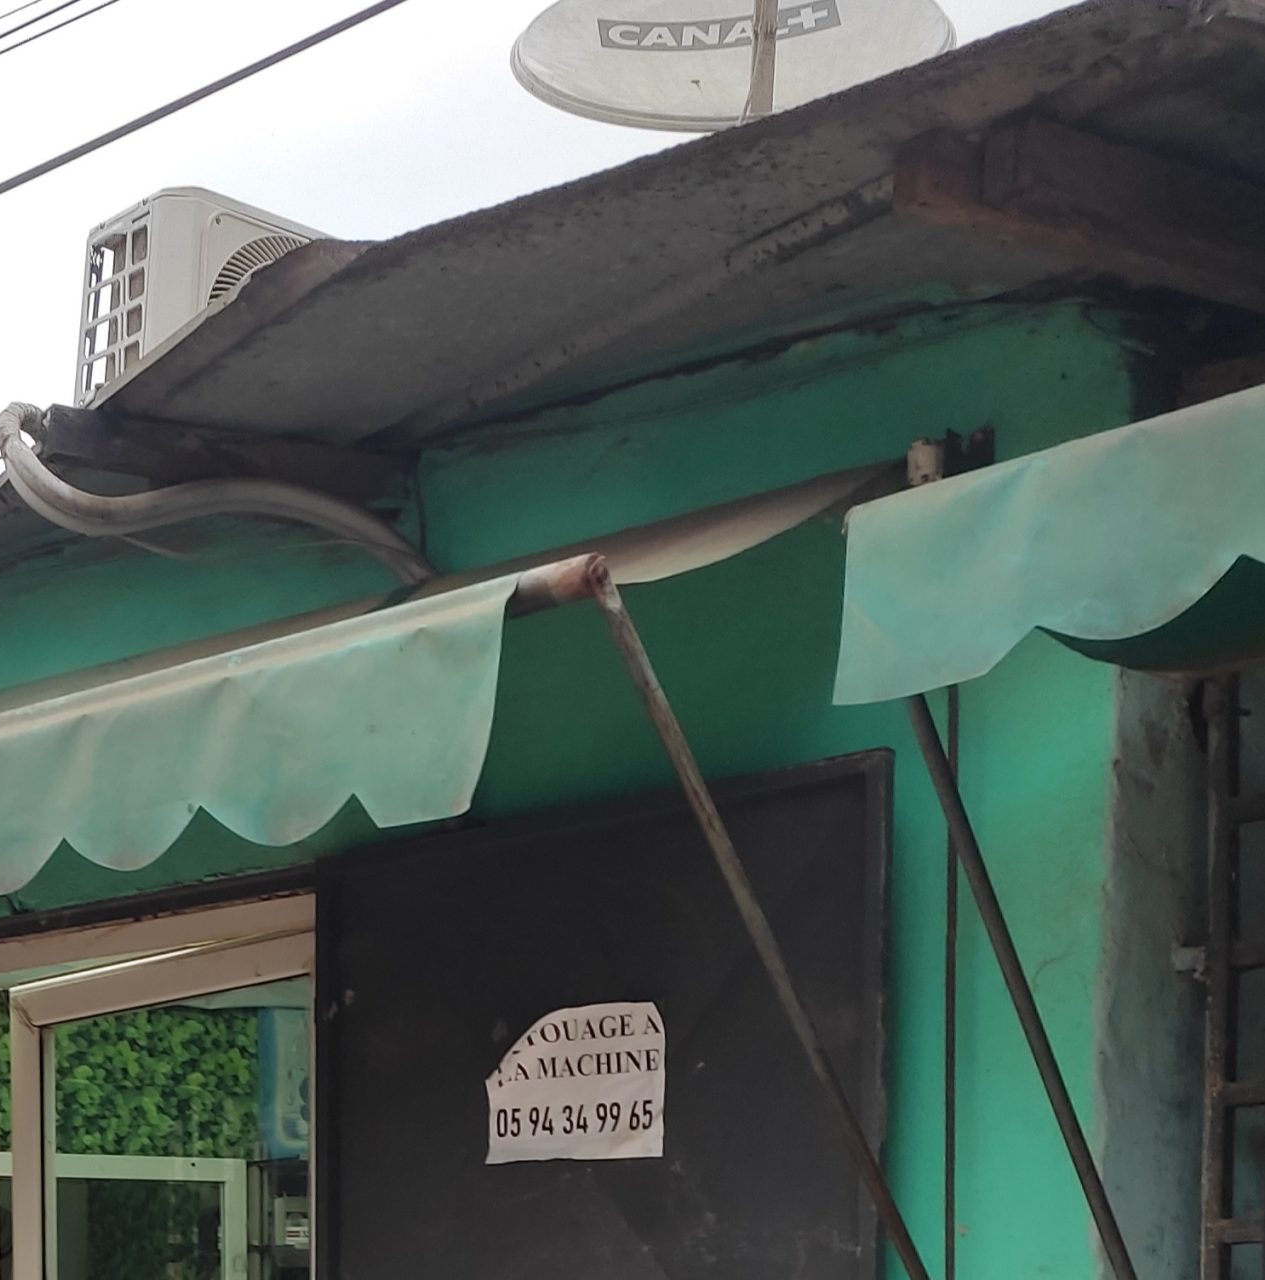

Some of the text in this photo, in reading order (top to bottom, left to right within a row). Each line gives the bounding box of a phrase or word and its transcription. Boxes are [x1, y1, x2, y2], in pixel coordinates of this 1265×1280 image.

[607, 5, 829, 47] CANA+
[512, 1014, 661, 1055] TOUAGE A
[537, 1049, 659, 1079] MACHINE
[496, 1100, 653, 1137] 05 94 34 99 65
